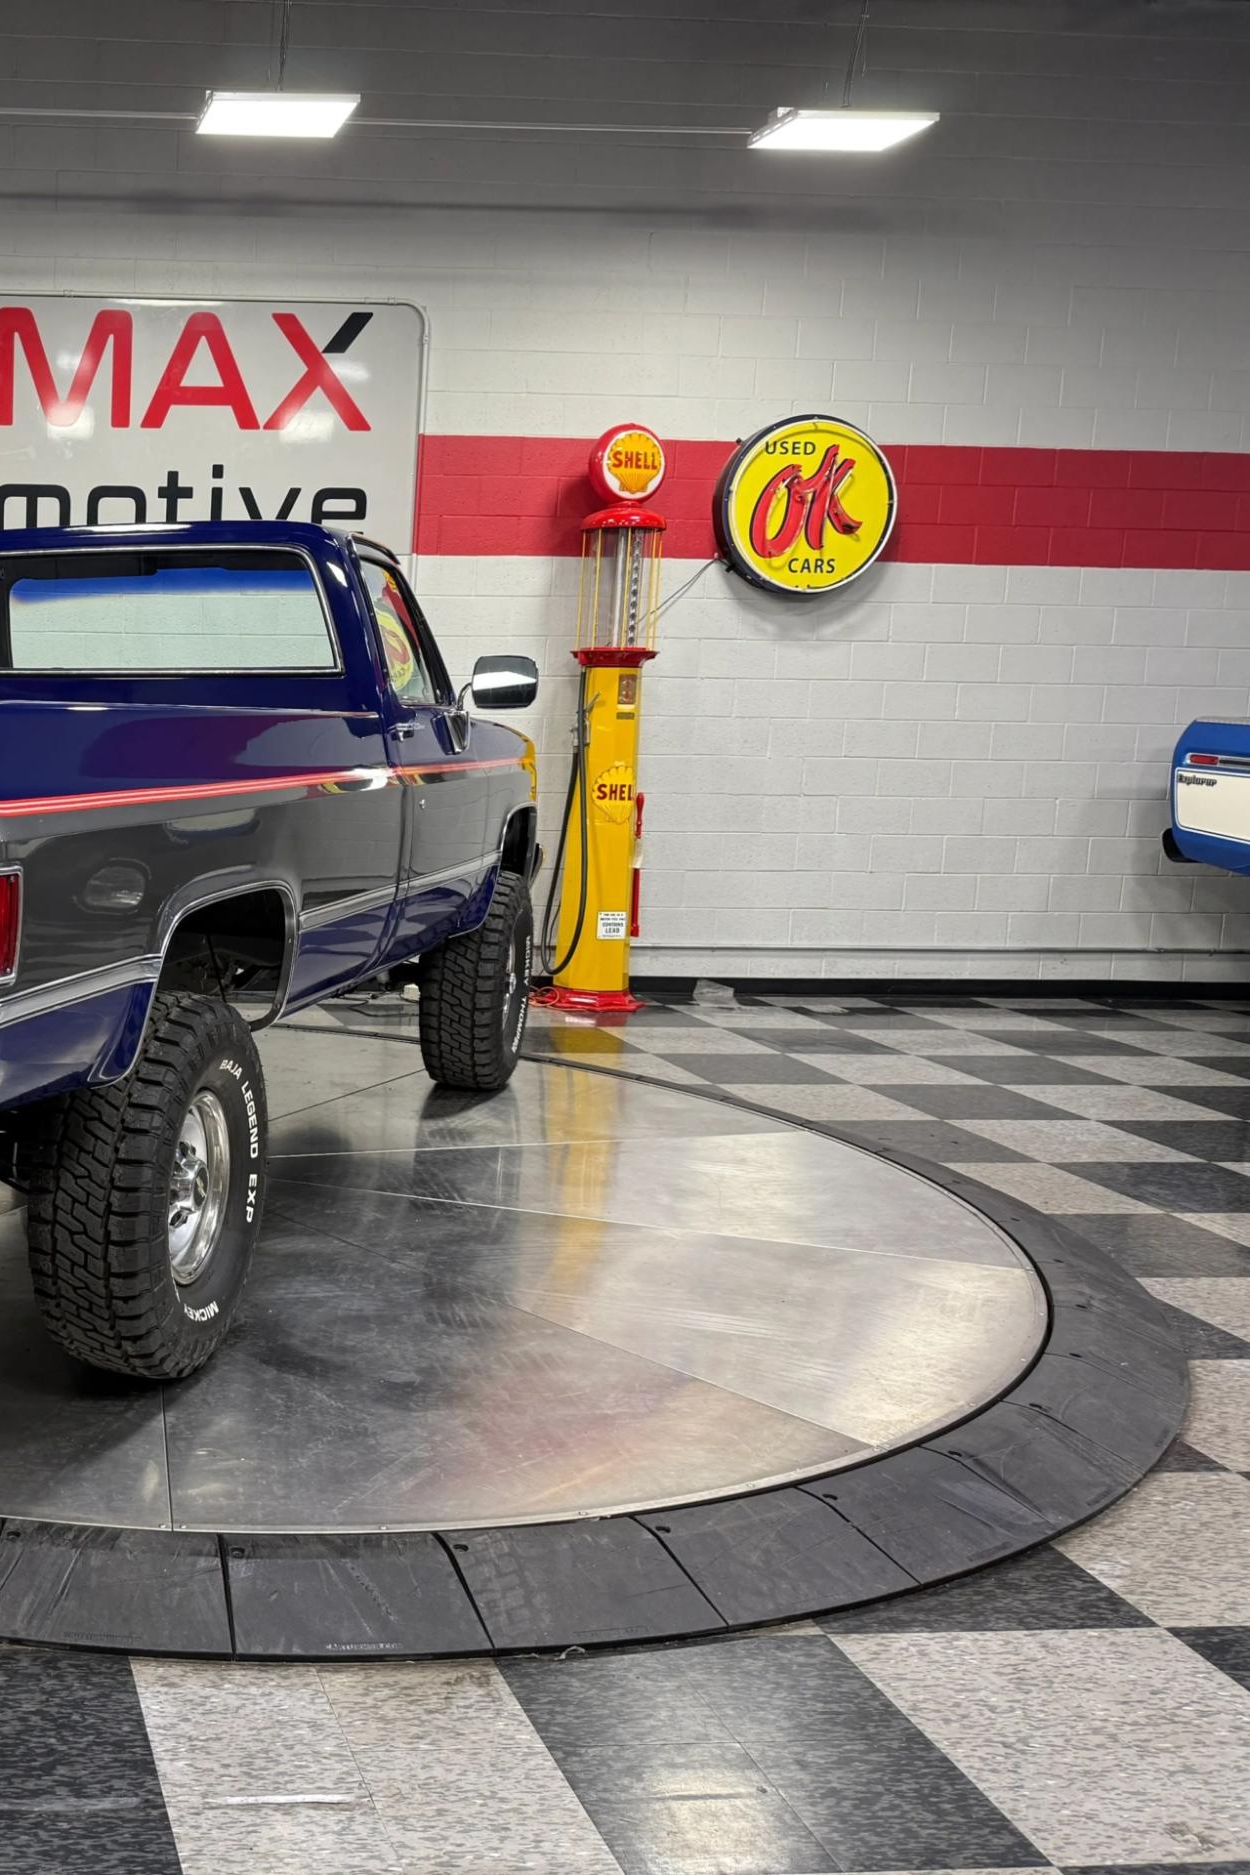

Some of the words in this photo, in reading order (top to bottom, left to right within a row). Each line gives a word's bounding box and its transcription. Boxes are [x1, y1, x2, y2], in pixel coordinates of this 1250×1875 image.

[765, 441, 816, 455] USED
[612, 450, 658, 470] SHELL
[750, 444, 862, 558] OK
[788, 558, 835, 574] CARS
[597, 784, 633, 801] SHEL
[219, 1059, 243, 1080] BAJA
[241, 1081, 259, 1159] LEGEND
[246, 1174, 258, 1223] EXP
